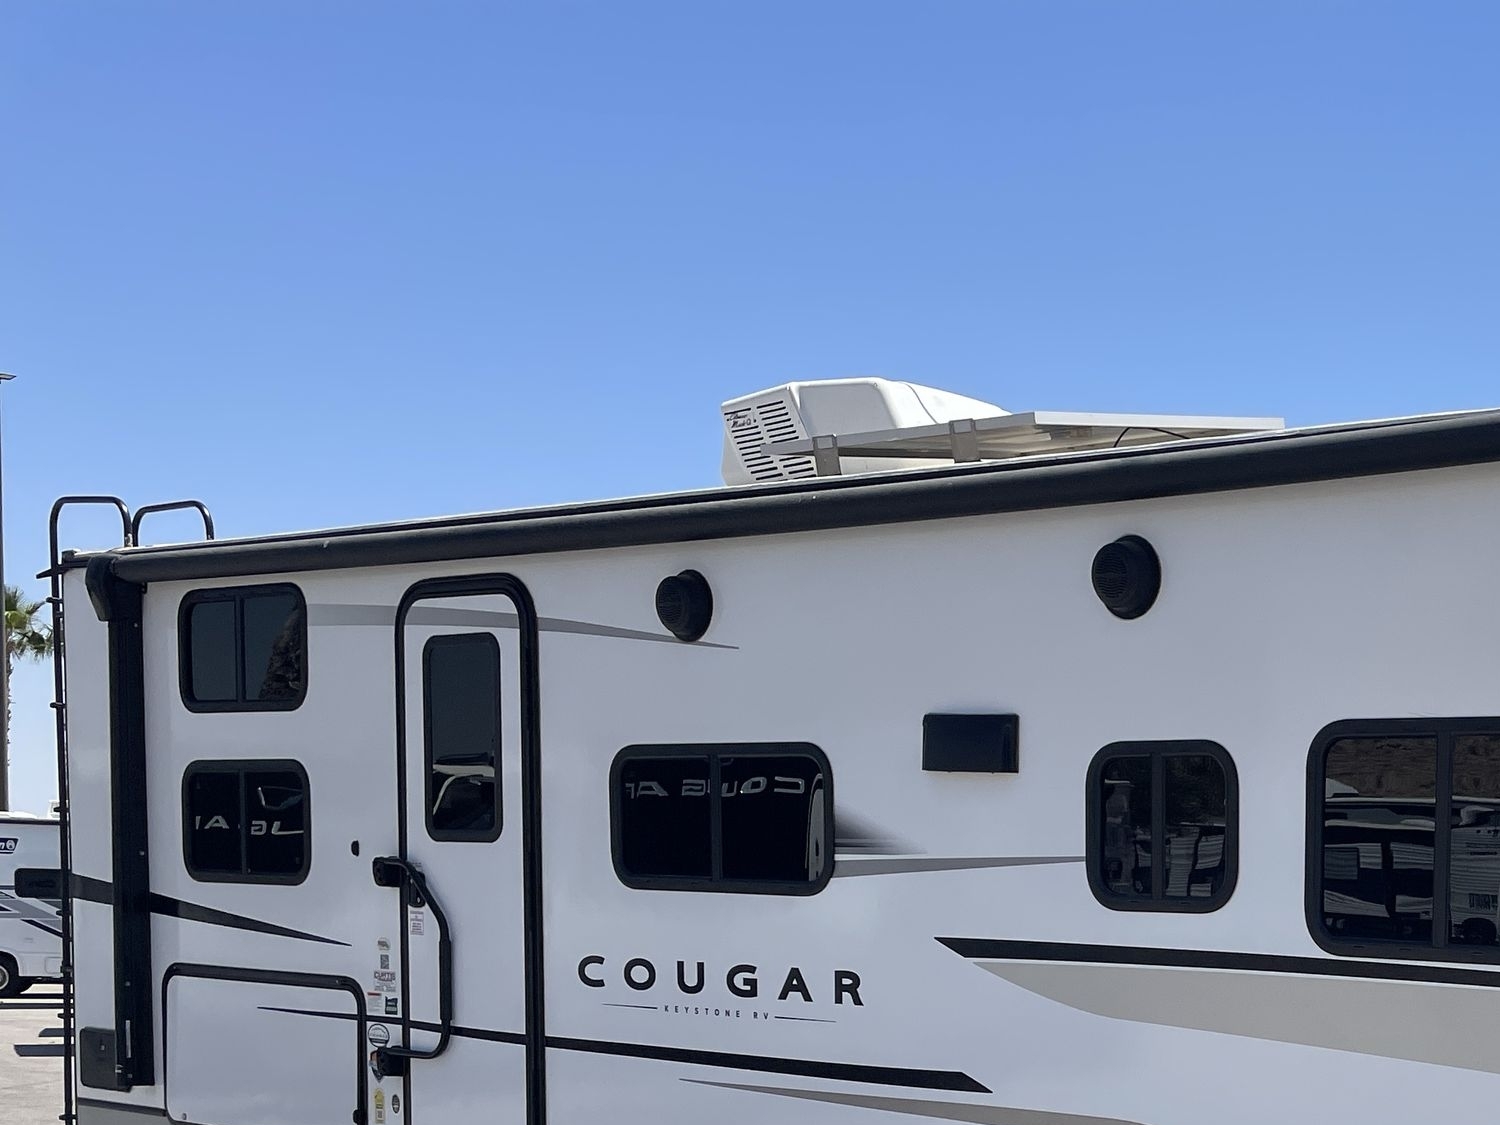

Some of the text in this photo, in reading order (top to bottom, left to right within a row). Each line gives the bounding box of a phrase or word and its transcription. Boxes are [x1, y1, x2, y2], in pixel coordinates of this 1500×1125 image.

[578, 955, 864, 1006] COUGAR
[664, 1005, 769, 1020] KEYSTONE RV
